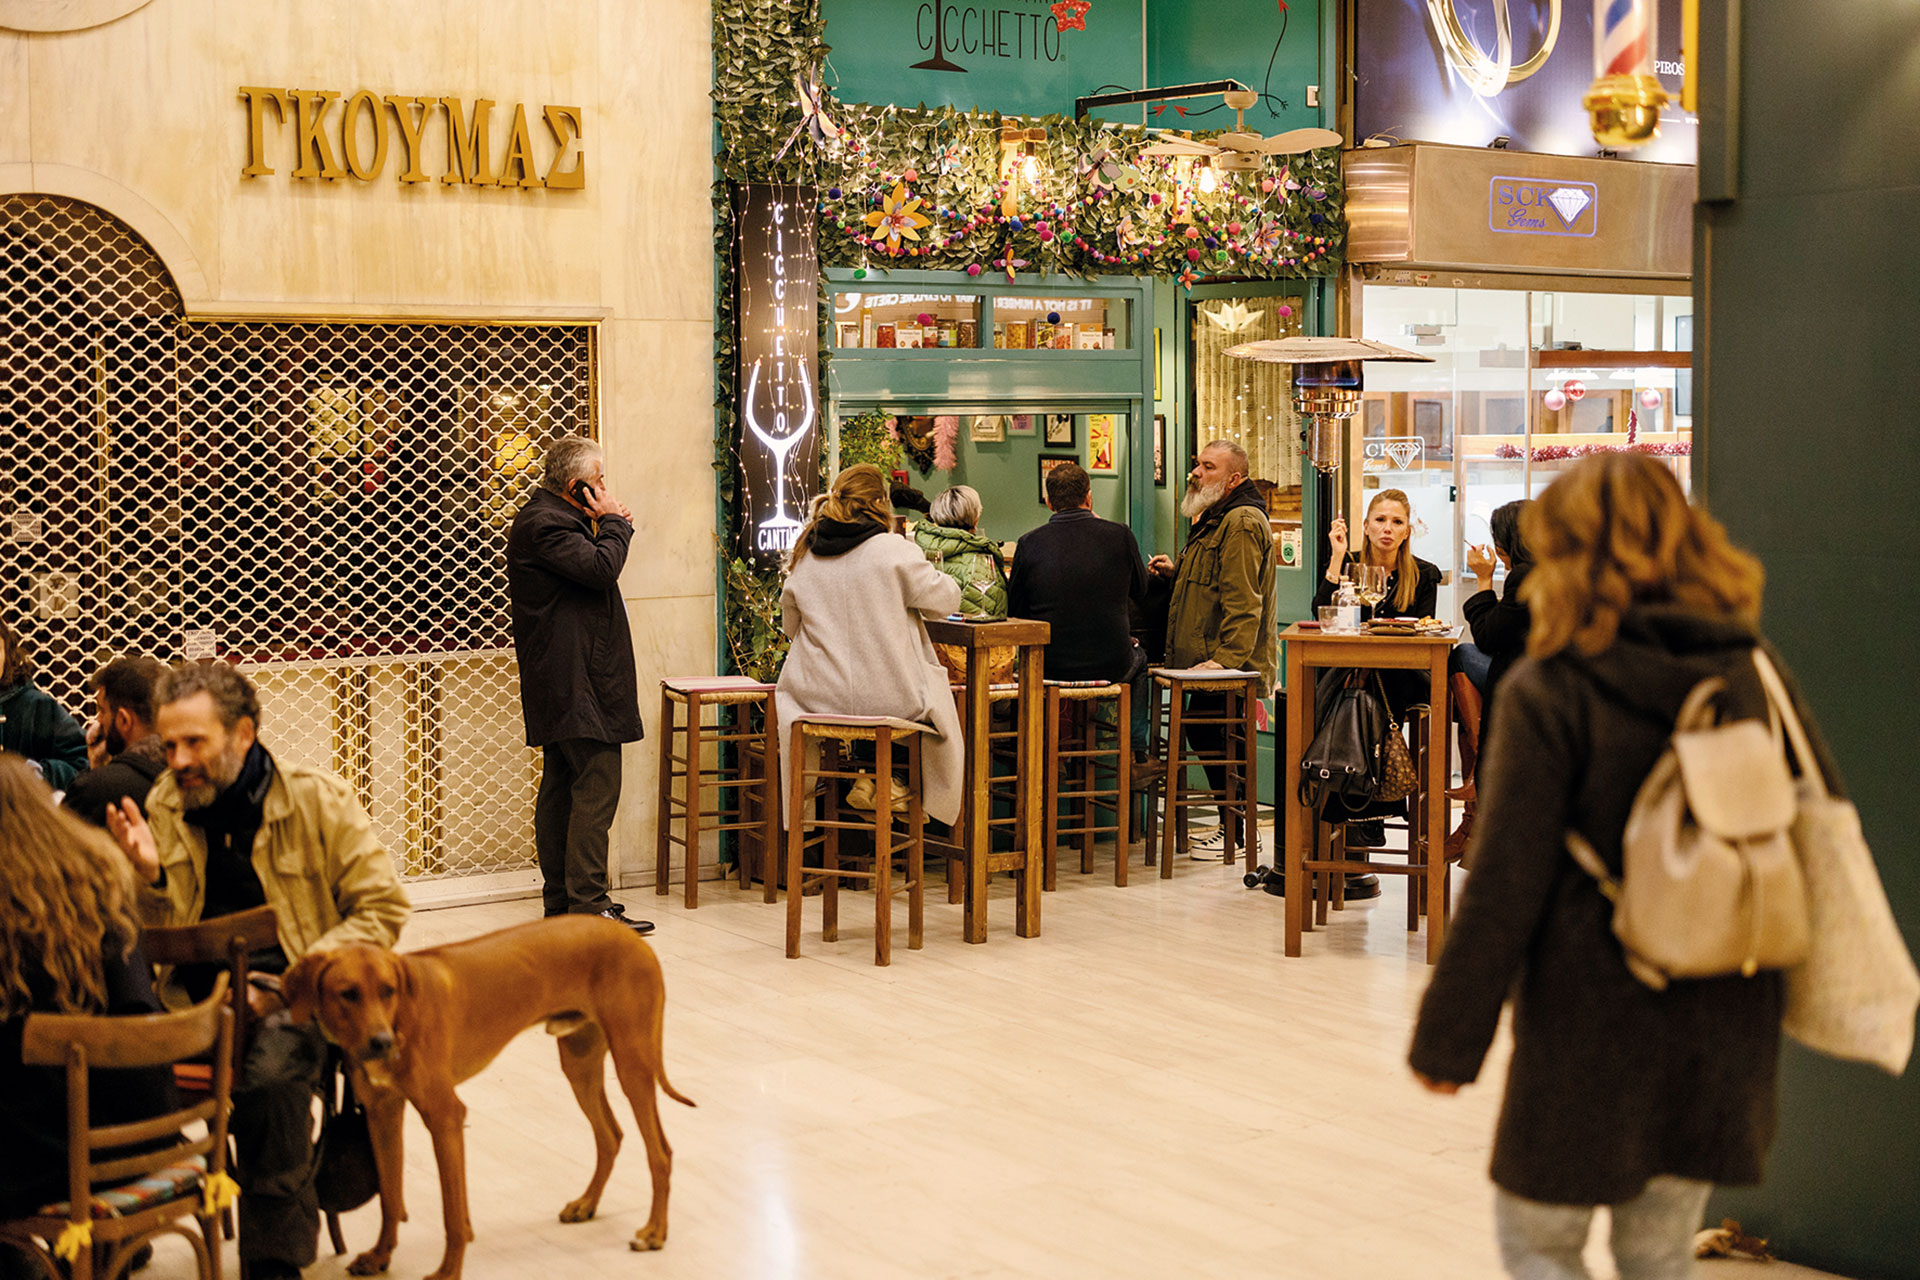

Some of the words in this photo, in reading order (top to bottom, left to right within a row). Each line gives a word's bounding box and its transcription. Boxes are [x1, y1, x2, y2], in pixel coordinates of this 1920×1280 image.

[239, 86, 585, 190] ΓΚΟΥΜΑΣ
[1507, 207, 1546, 228] Gems
[774, 203, 787, 433] CICCHETTO
